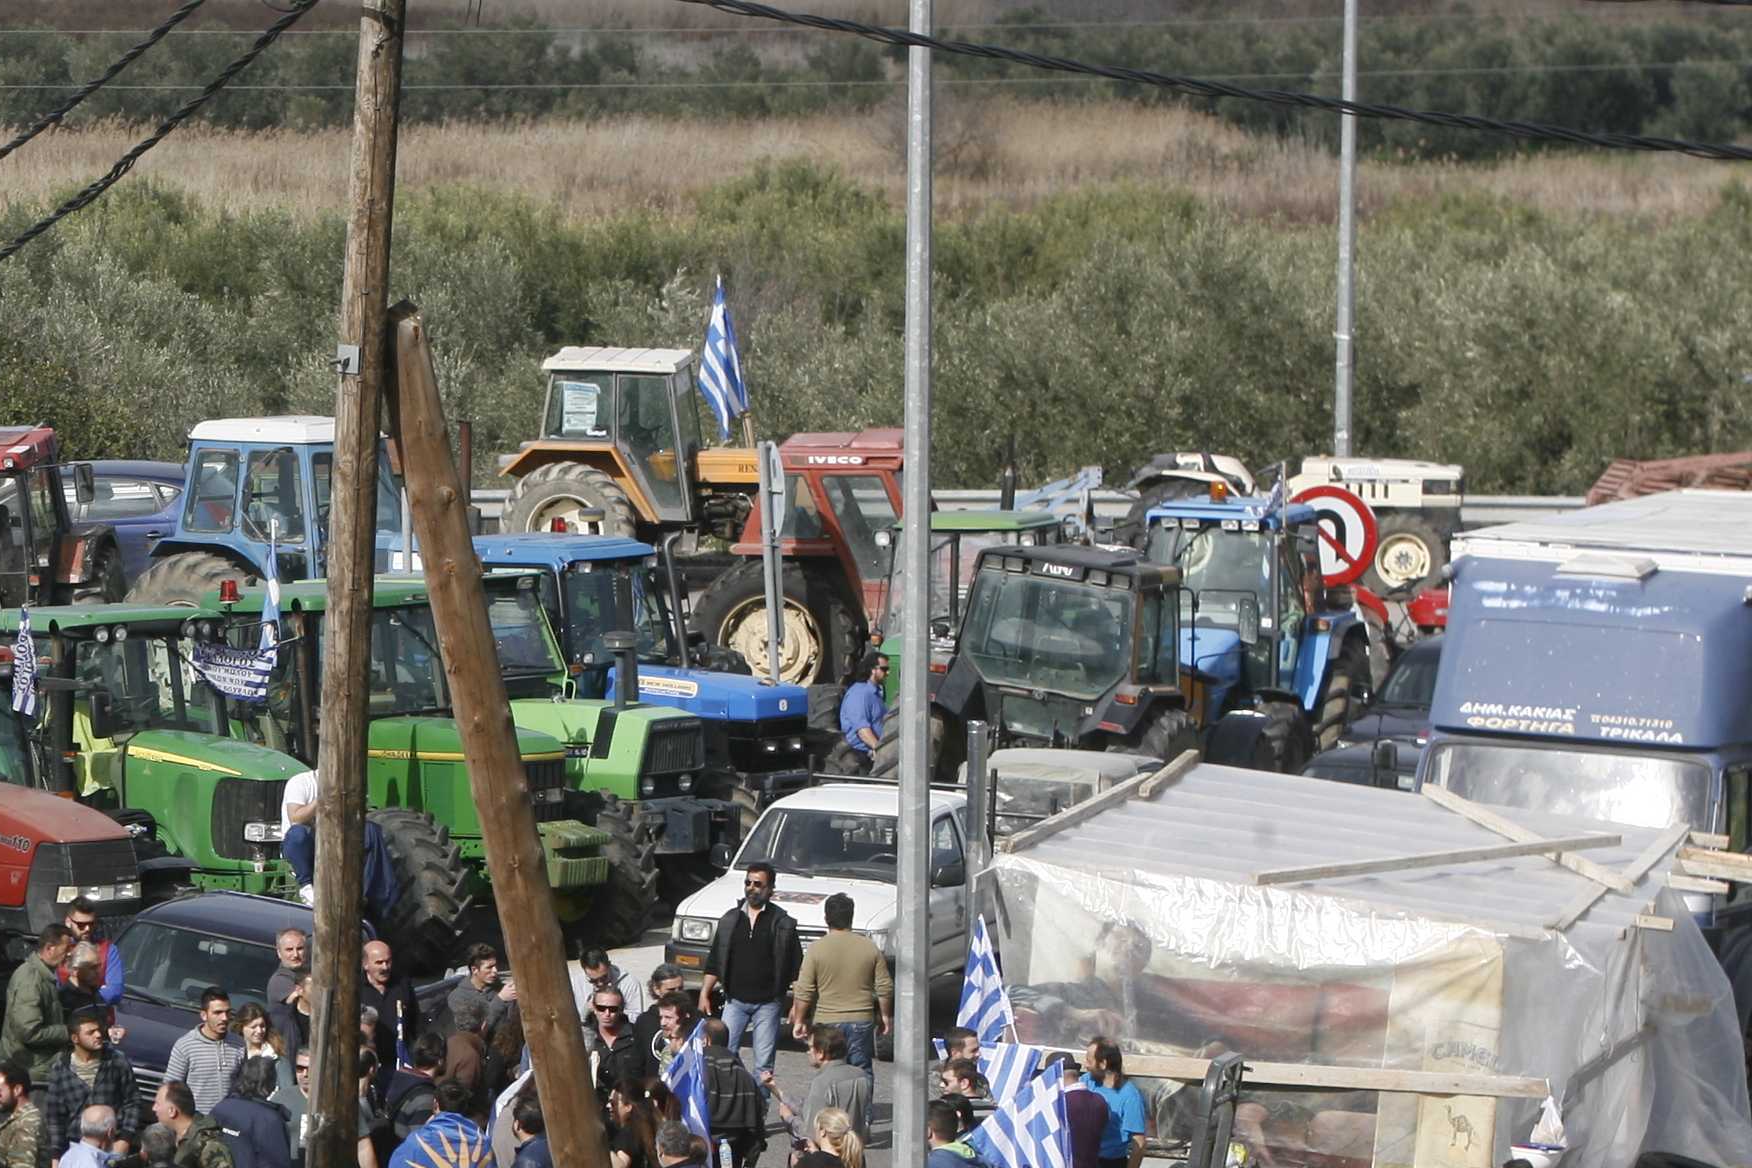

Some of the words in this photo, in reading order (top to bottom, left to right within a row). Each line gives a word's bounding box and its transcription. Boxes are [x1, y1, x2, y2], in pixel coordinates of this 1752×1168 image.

[808, 456, 863, 465] IVECO
[1466, 716, 1576, 734] ΦΟΡΤΗΓΑ
[1600, 726, 1684, 743] ΤΡΙΚΑΛΑ
